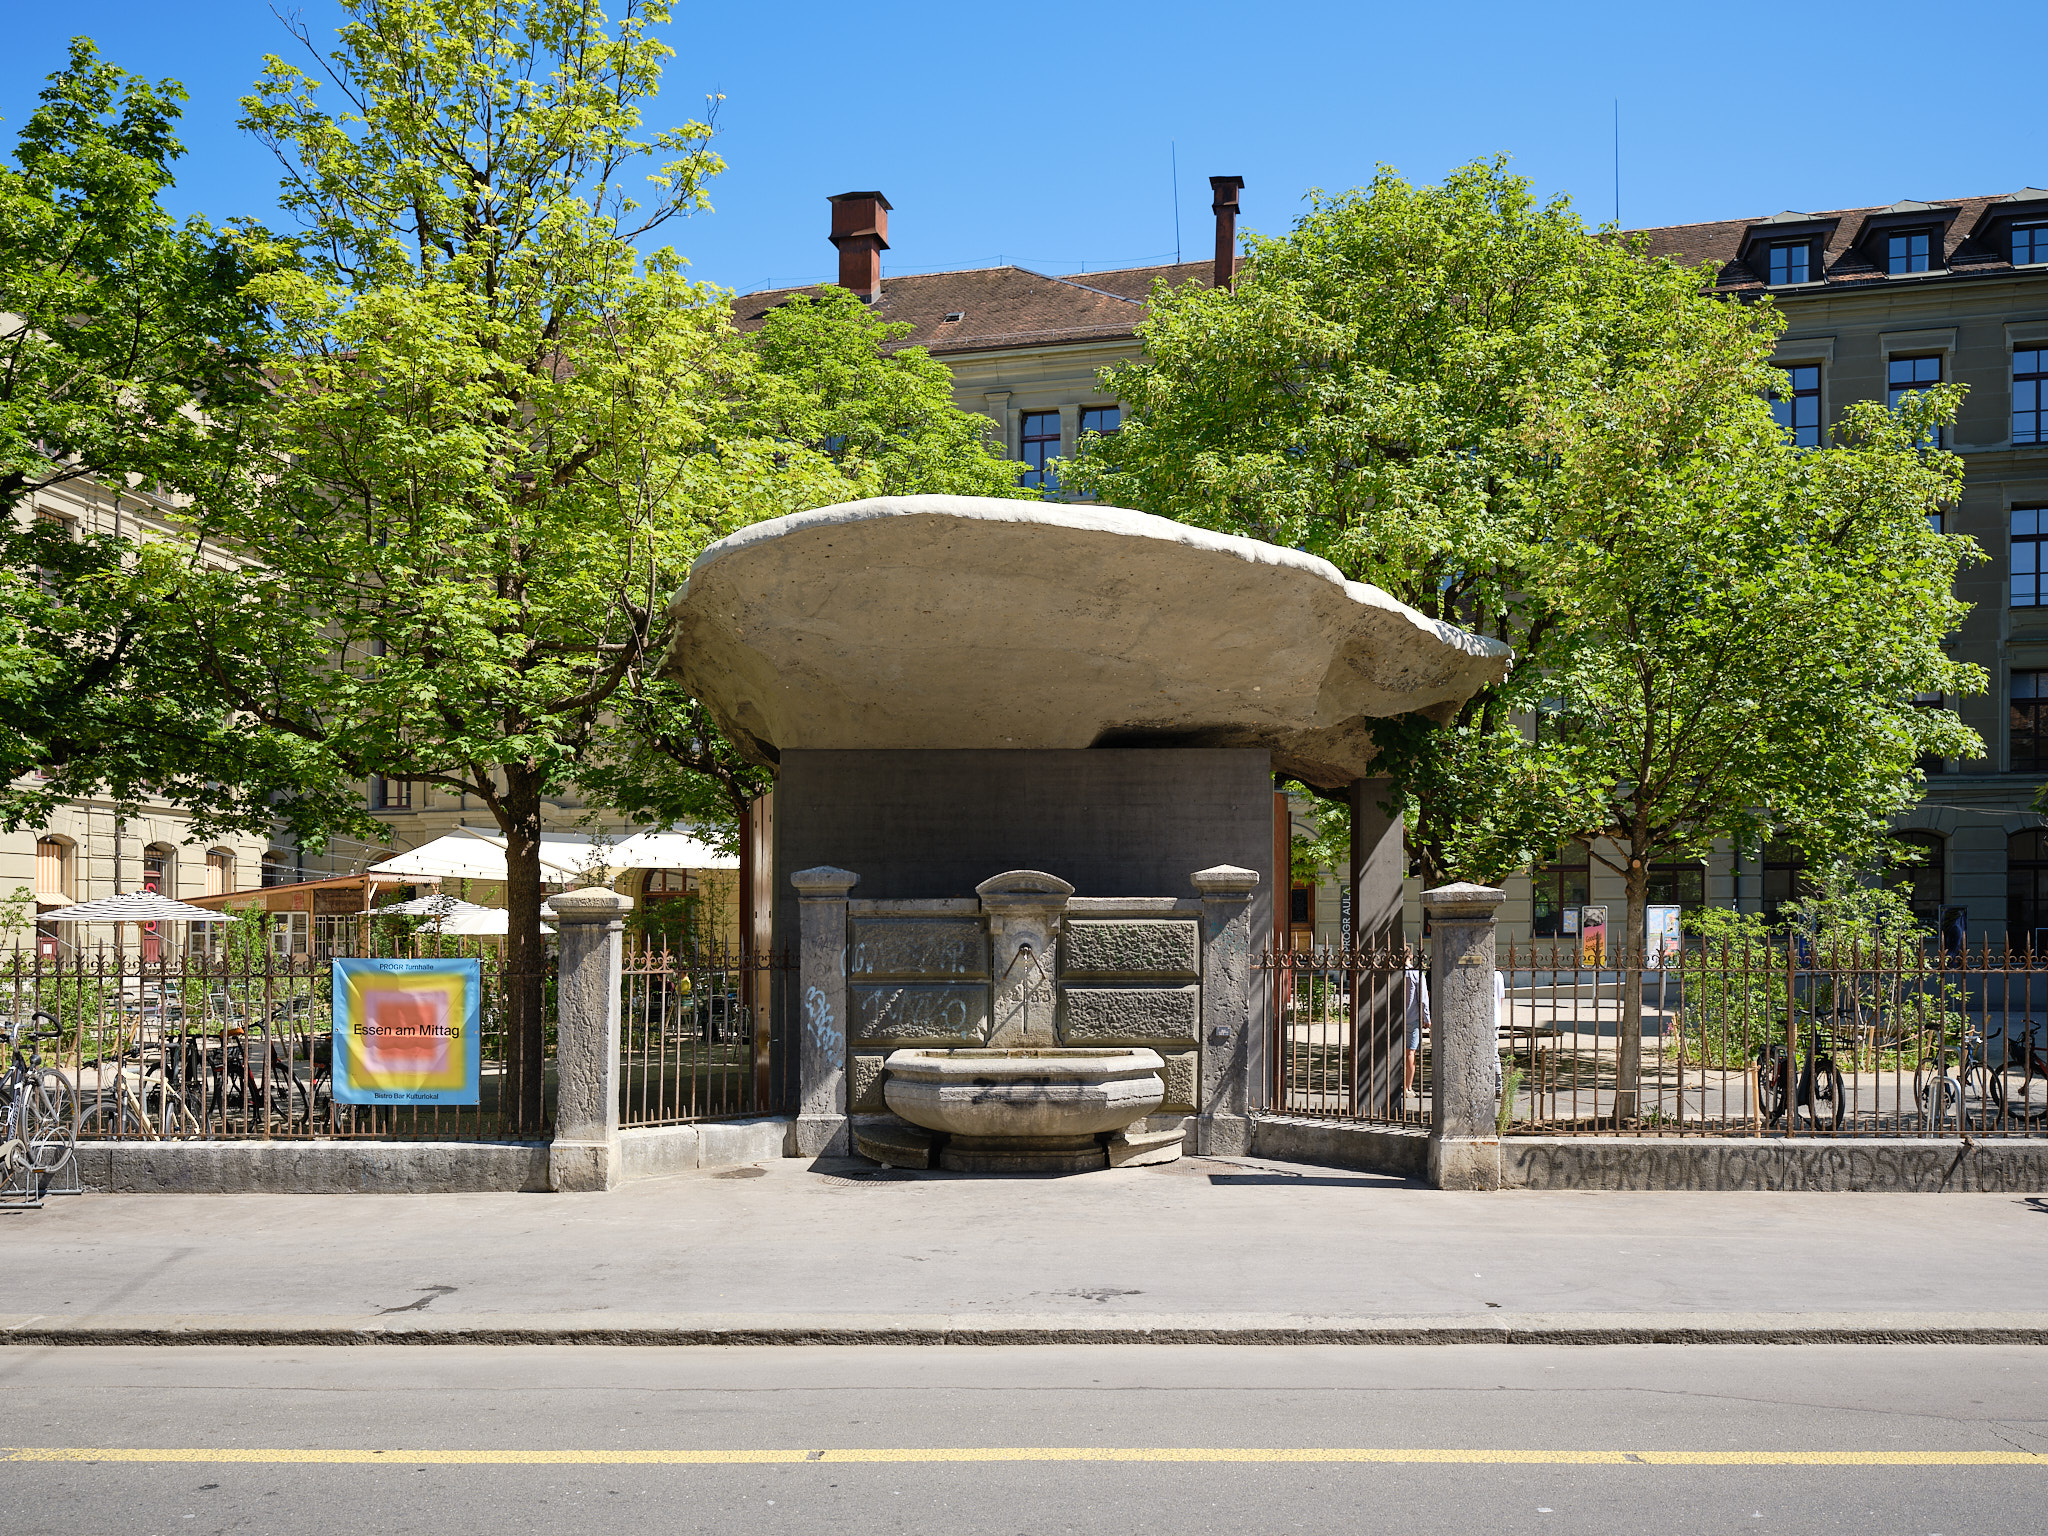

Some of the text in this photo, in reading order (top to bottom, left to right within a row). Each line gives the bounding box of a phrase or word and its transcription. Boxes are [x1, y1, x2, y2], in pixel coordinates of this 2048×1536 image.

[1342, 917, 1351, 952] PROGR
[405, 963, 434, 971] Turnhalle
[353, 1023, 460, 1039] Essen am Mittag
[406, 1092, 439, 1100] Kulturlokal
